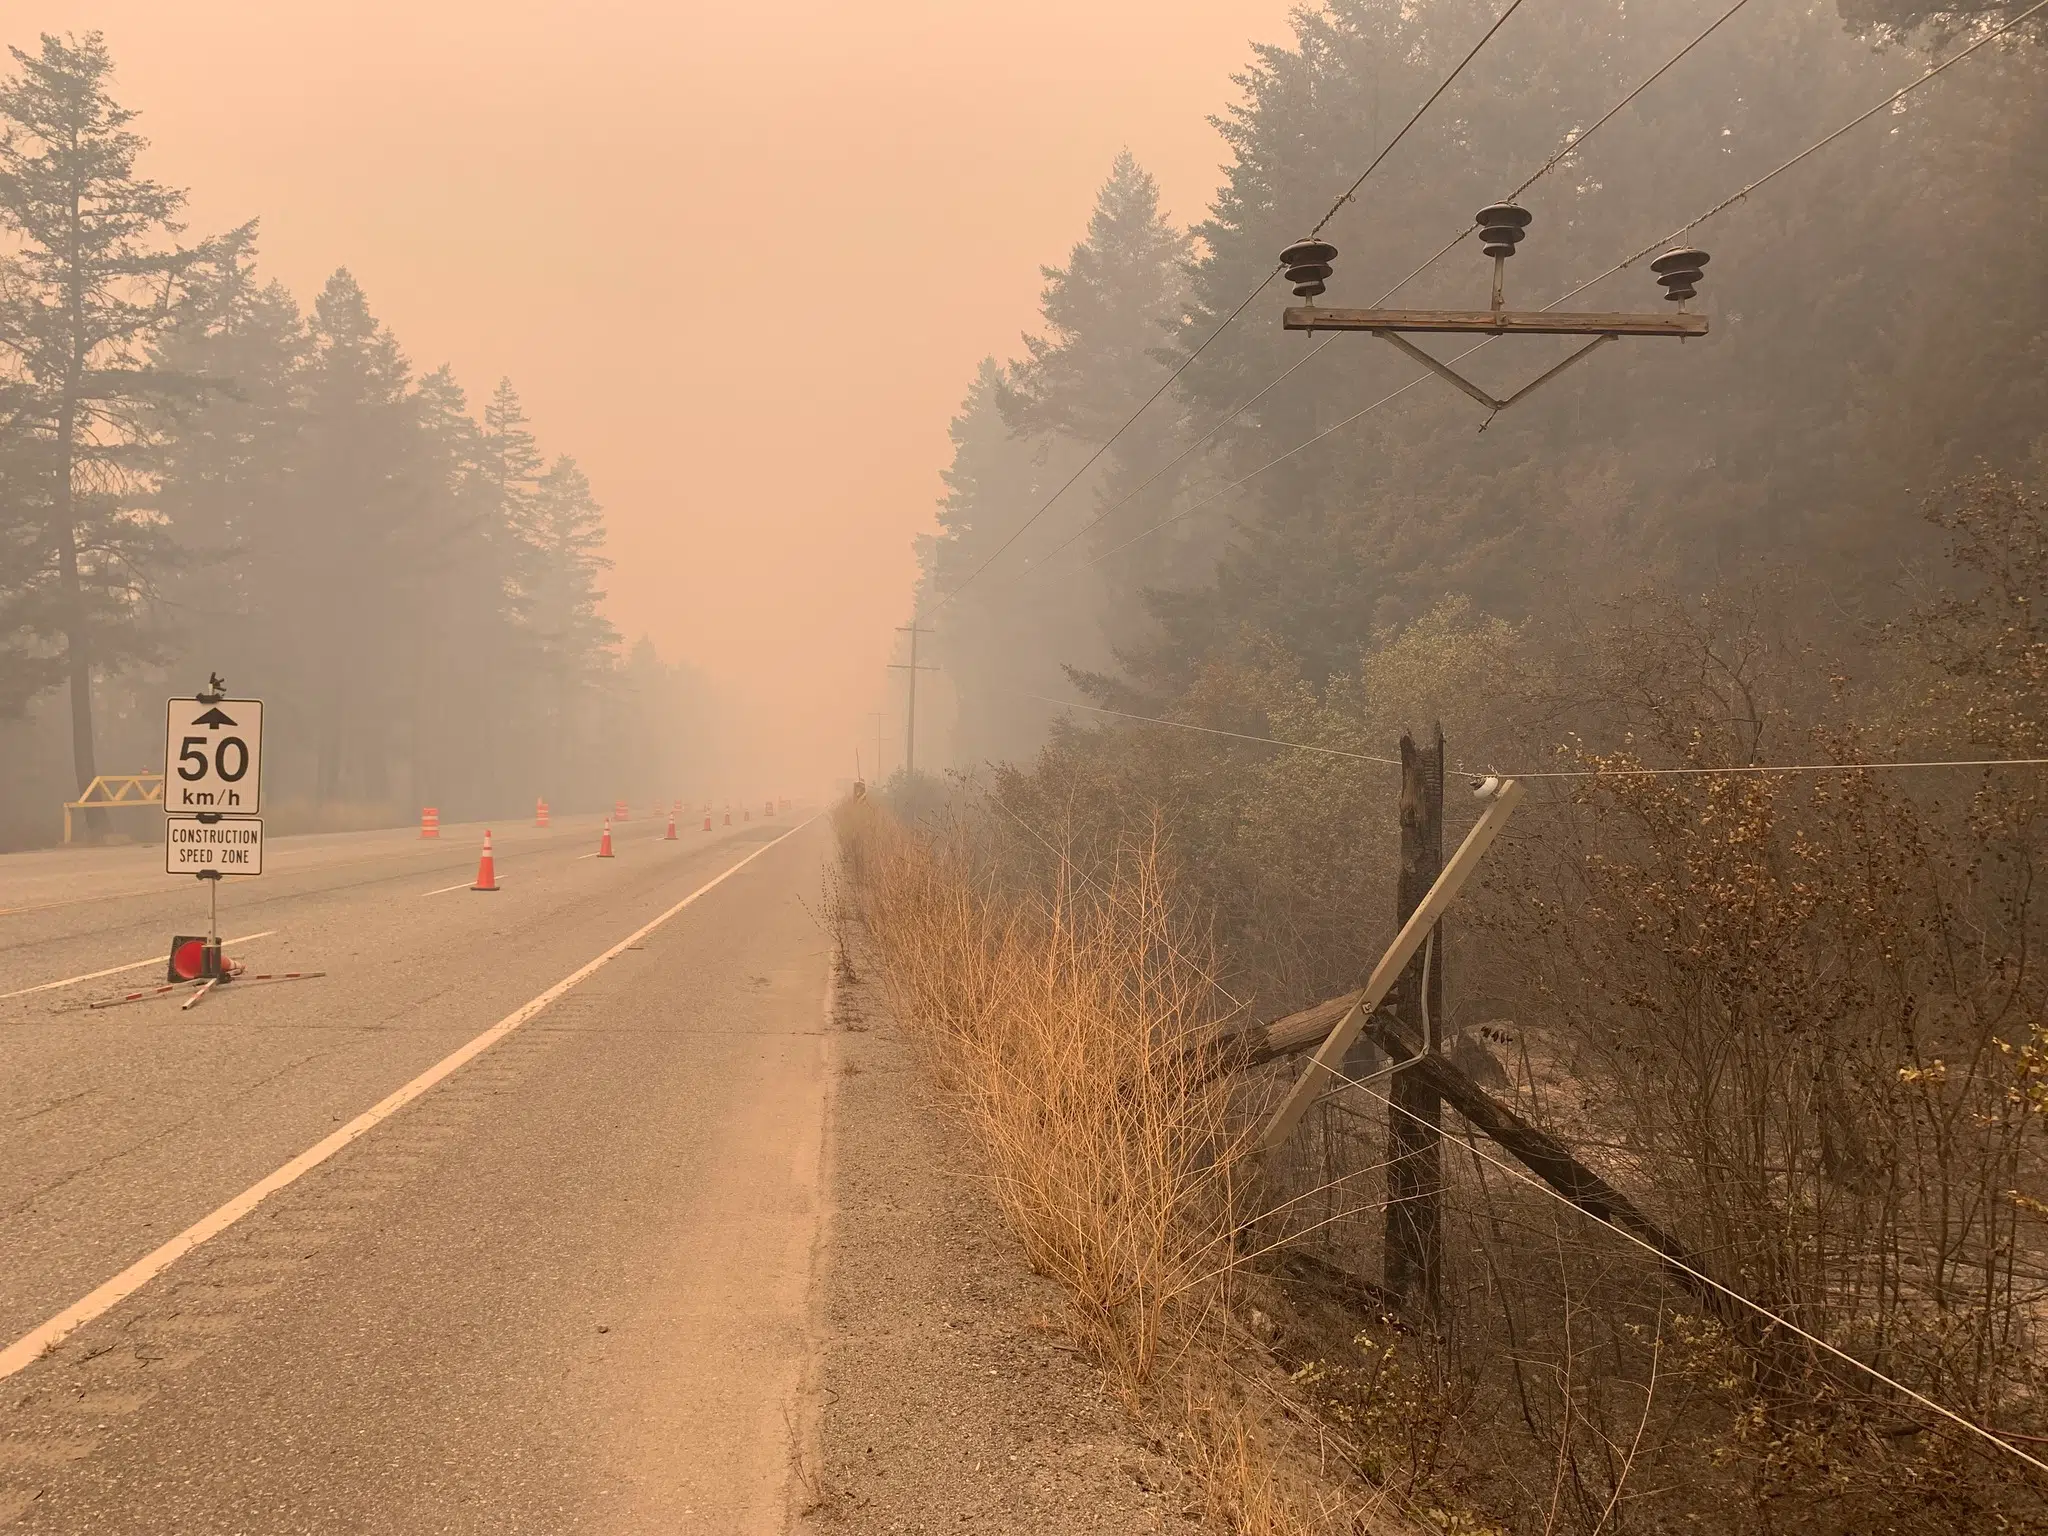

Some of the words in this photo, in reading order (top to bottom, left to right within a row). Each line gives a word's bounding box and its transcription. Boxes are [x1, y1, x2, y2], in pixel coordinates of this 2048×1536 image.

[177, 736, 249, 782] 50
[182, 788, 240, 806] km/h
[172, 828, 258, 844] CONSTRUCTION
[179, 848, 213, 863] SPEED
[221, 849, 249, 864] ZONE
